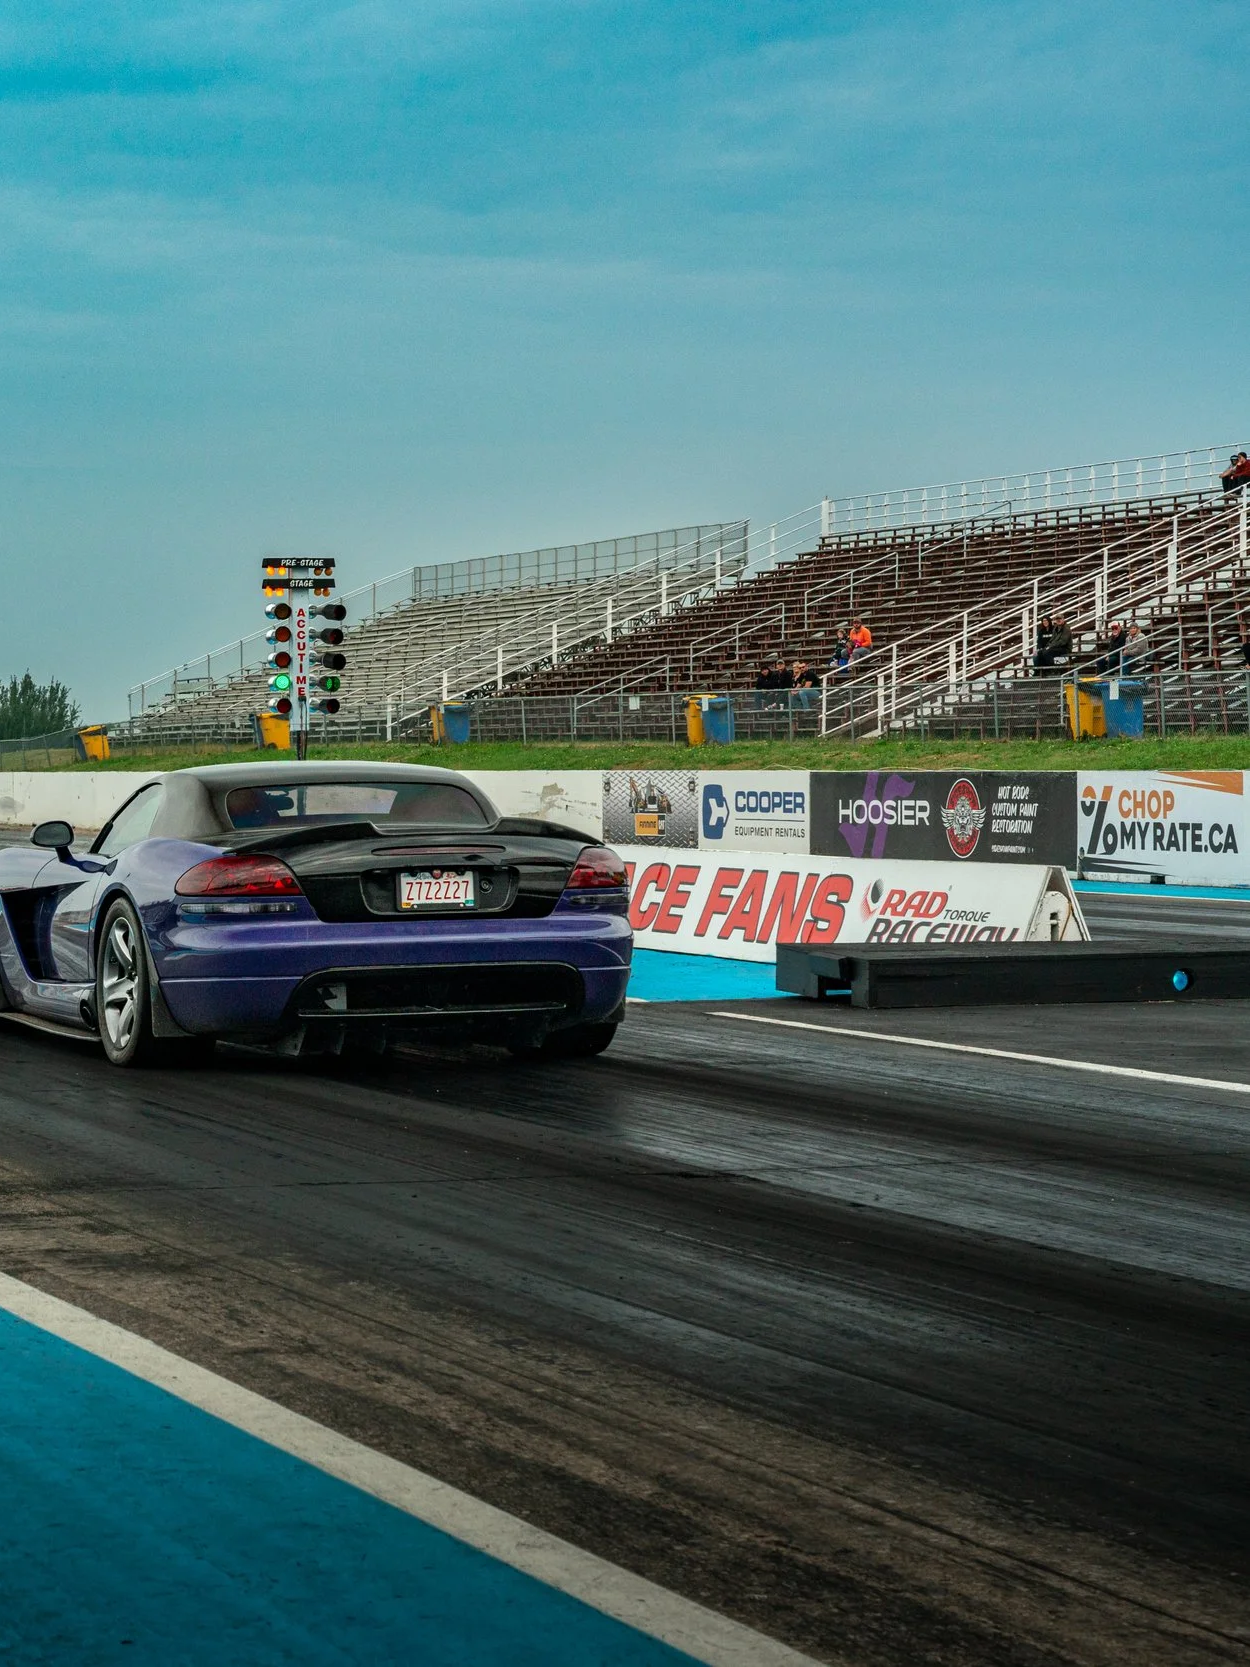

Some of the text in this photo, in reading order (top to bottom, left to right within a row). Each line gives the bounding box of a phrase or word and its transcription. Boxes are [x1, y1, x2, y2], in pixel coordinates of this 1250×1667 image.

[281, 559, 324, 567] PRE-STAGE
[296, 608, 307, 696] ACCUTIME
[735, 791, 805, 814] COOPER
[998, 786, 1029, 799] HOT RODS
[838, 799, 930, 826] HOOSIER
[992, 803, 1038, 817] CUSTOM PAINT
[1118, 790, 1174, 819] CHOP
[735, 826, 805, 838] EQUIPMENT RENTALS
[991, 819, 1033, 834] RESTORATION
[694, 867, 854, 944] FANS
[879, 889, 991, 922] RAD TORQUE
